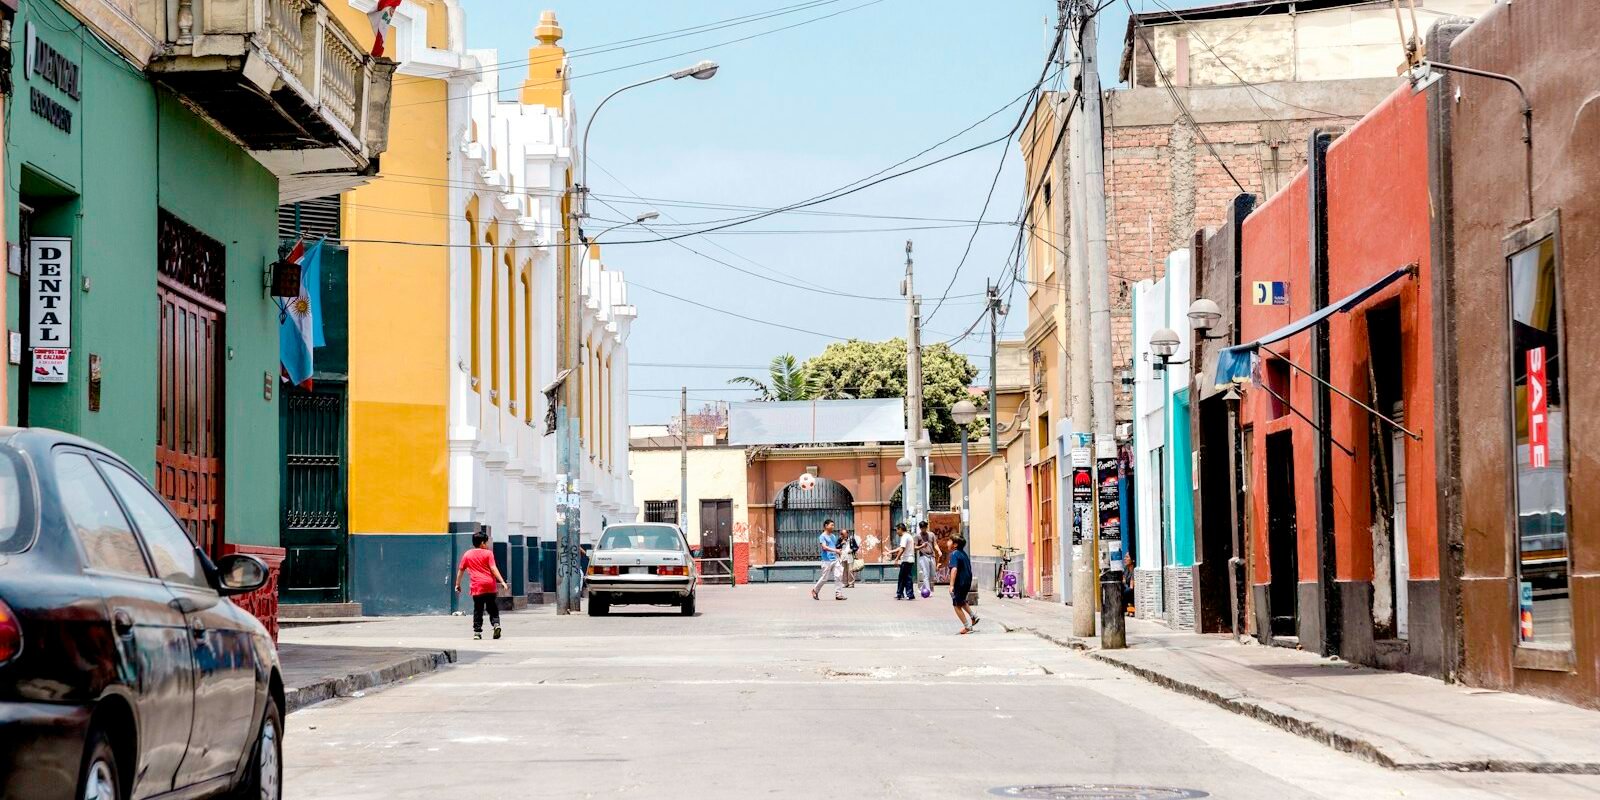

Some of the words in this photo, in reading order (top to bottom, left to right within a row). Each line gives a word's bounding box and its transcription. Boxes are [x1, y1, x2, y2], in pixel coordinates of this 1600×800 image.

[33, 36, 81, 101] DENTAL
[38, 247, 62, 341] DENTAL
[1530, 347, 1545, 468] SALE
